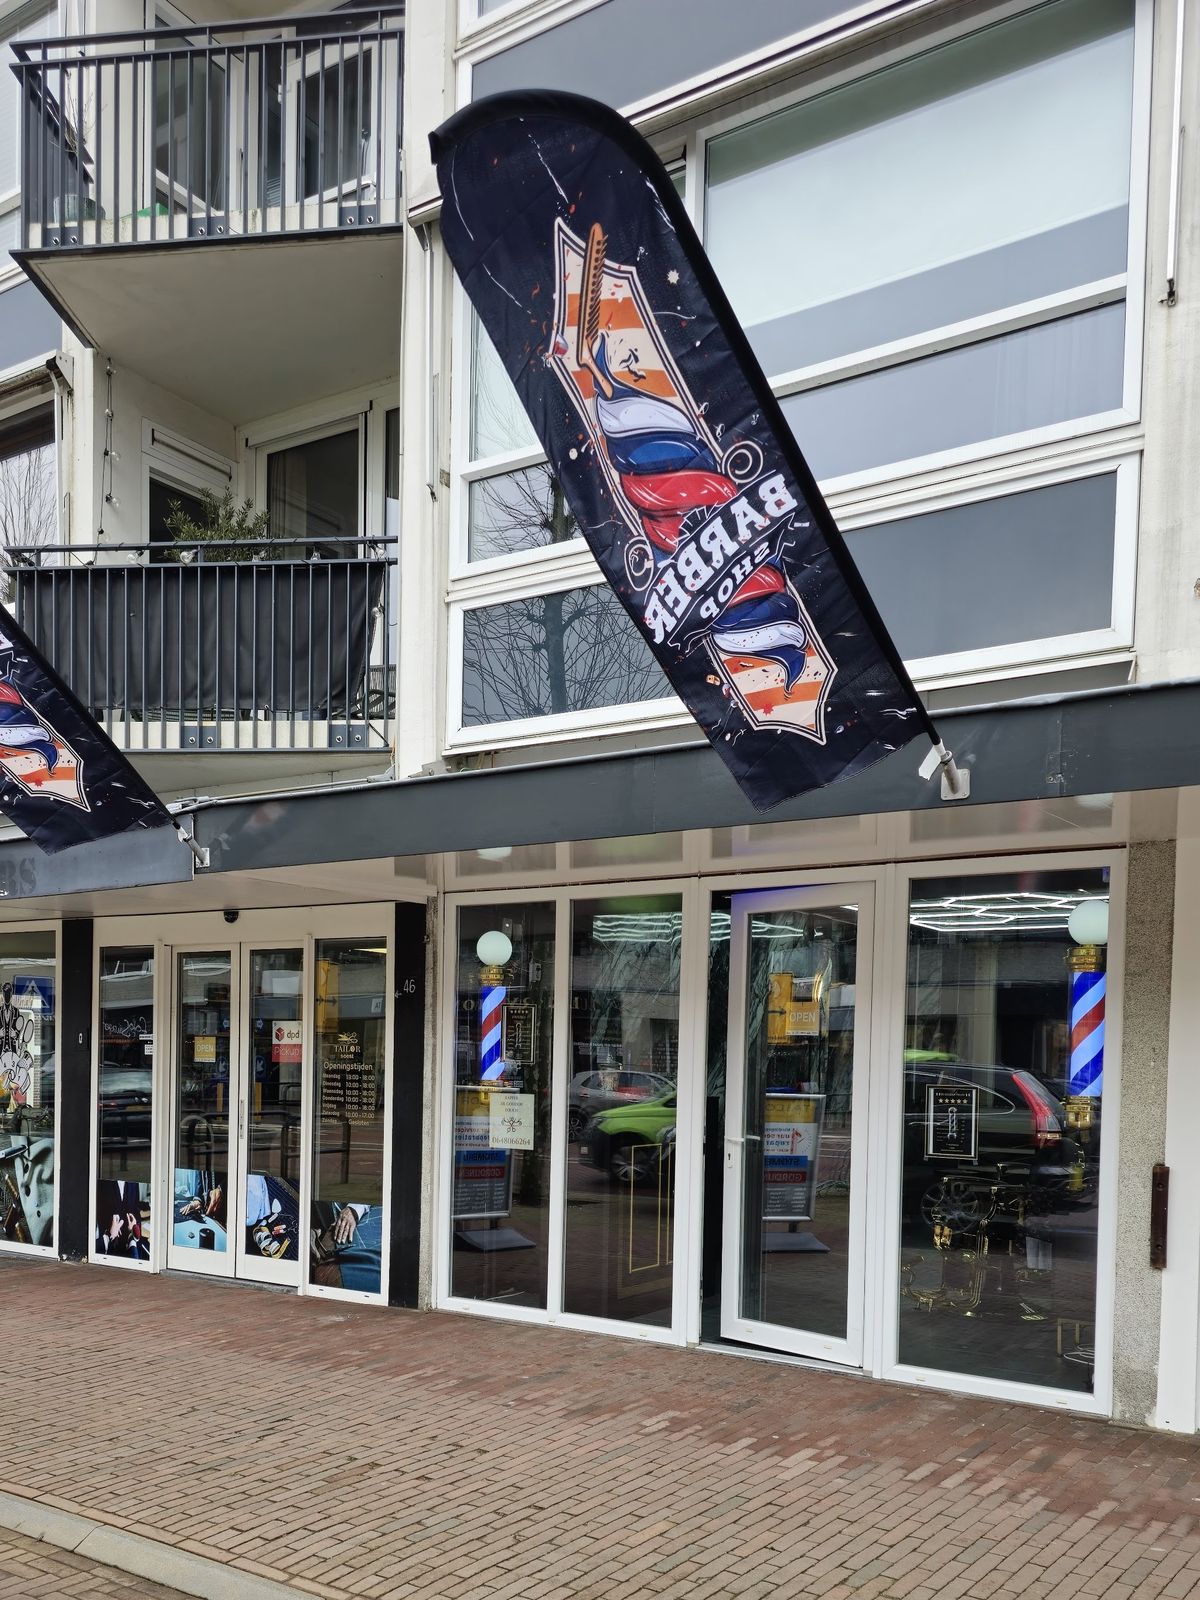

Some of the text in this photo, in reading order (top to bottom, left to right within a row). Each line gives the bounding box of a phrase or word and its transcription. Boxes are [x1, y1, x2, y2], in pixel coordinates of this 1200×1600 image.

[403, 979, 416, 993] 46
[789, 1012, 816, 1022] OPEN
[286, 1030, 300, 1040] dpd
[196, 1044, 214, 1052] OPEN
[274, 1046, 300, 1056] Pickup
[334, 1045, 361, 1053] TAILOR
[323, 1061, 373, 1071] Openingstijden
